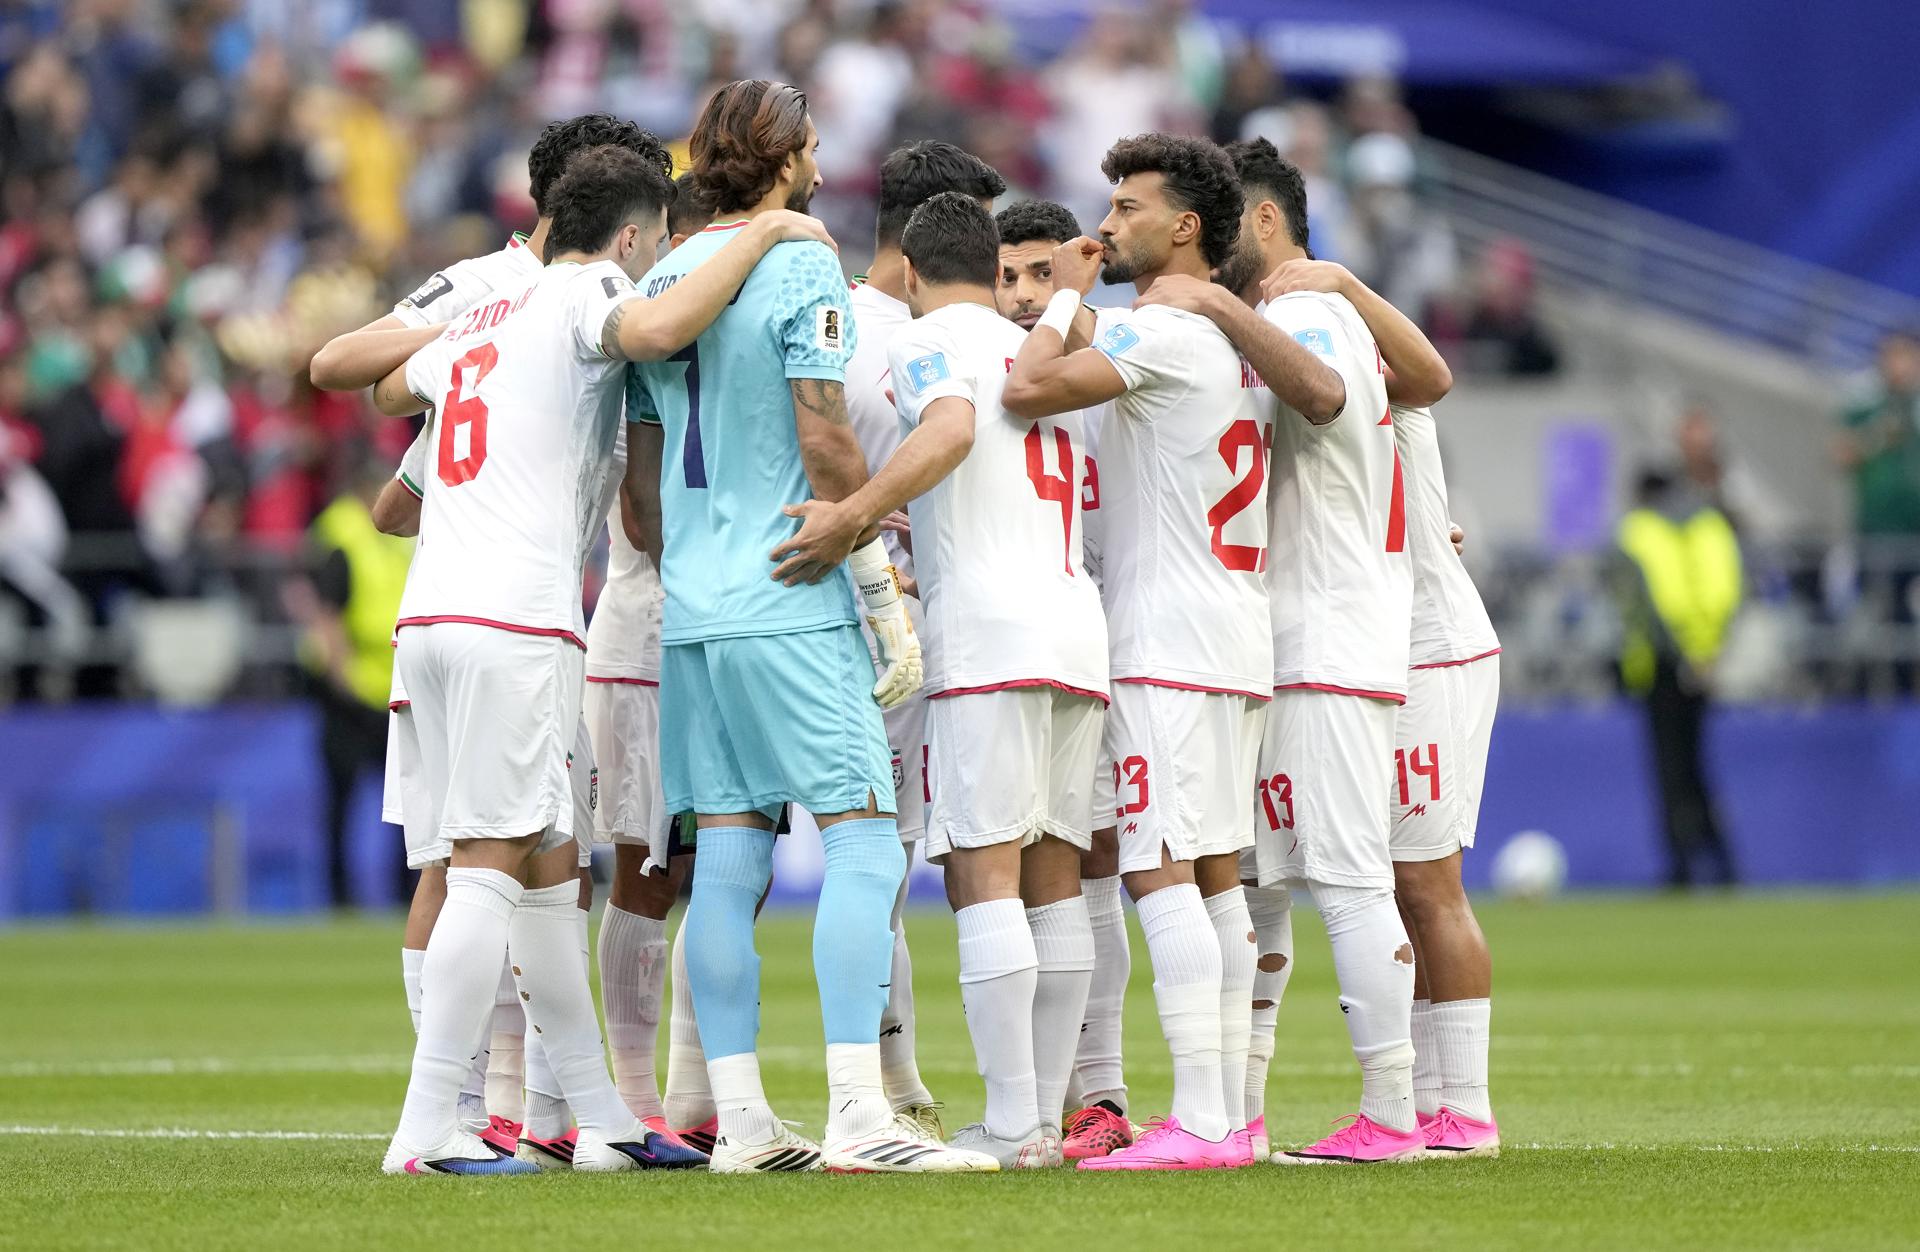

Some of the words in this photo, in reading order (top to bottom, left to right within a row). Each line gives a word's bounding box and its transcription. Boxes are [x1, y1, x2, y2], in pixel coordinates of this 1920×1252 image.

[438, 342, 498, 487] 6
[1024, 420, 1074, 577] 4
[1207, 420, 1272, 573] 2
[1259, 774, 1295, 831] 13
[1395, 744, 1440, 805] 14
